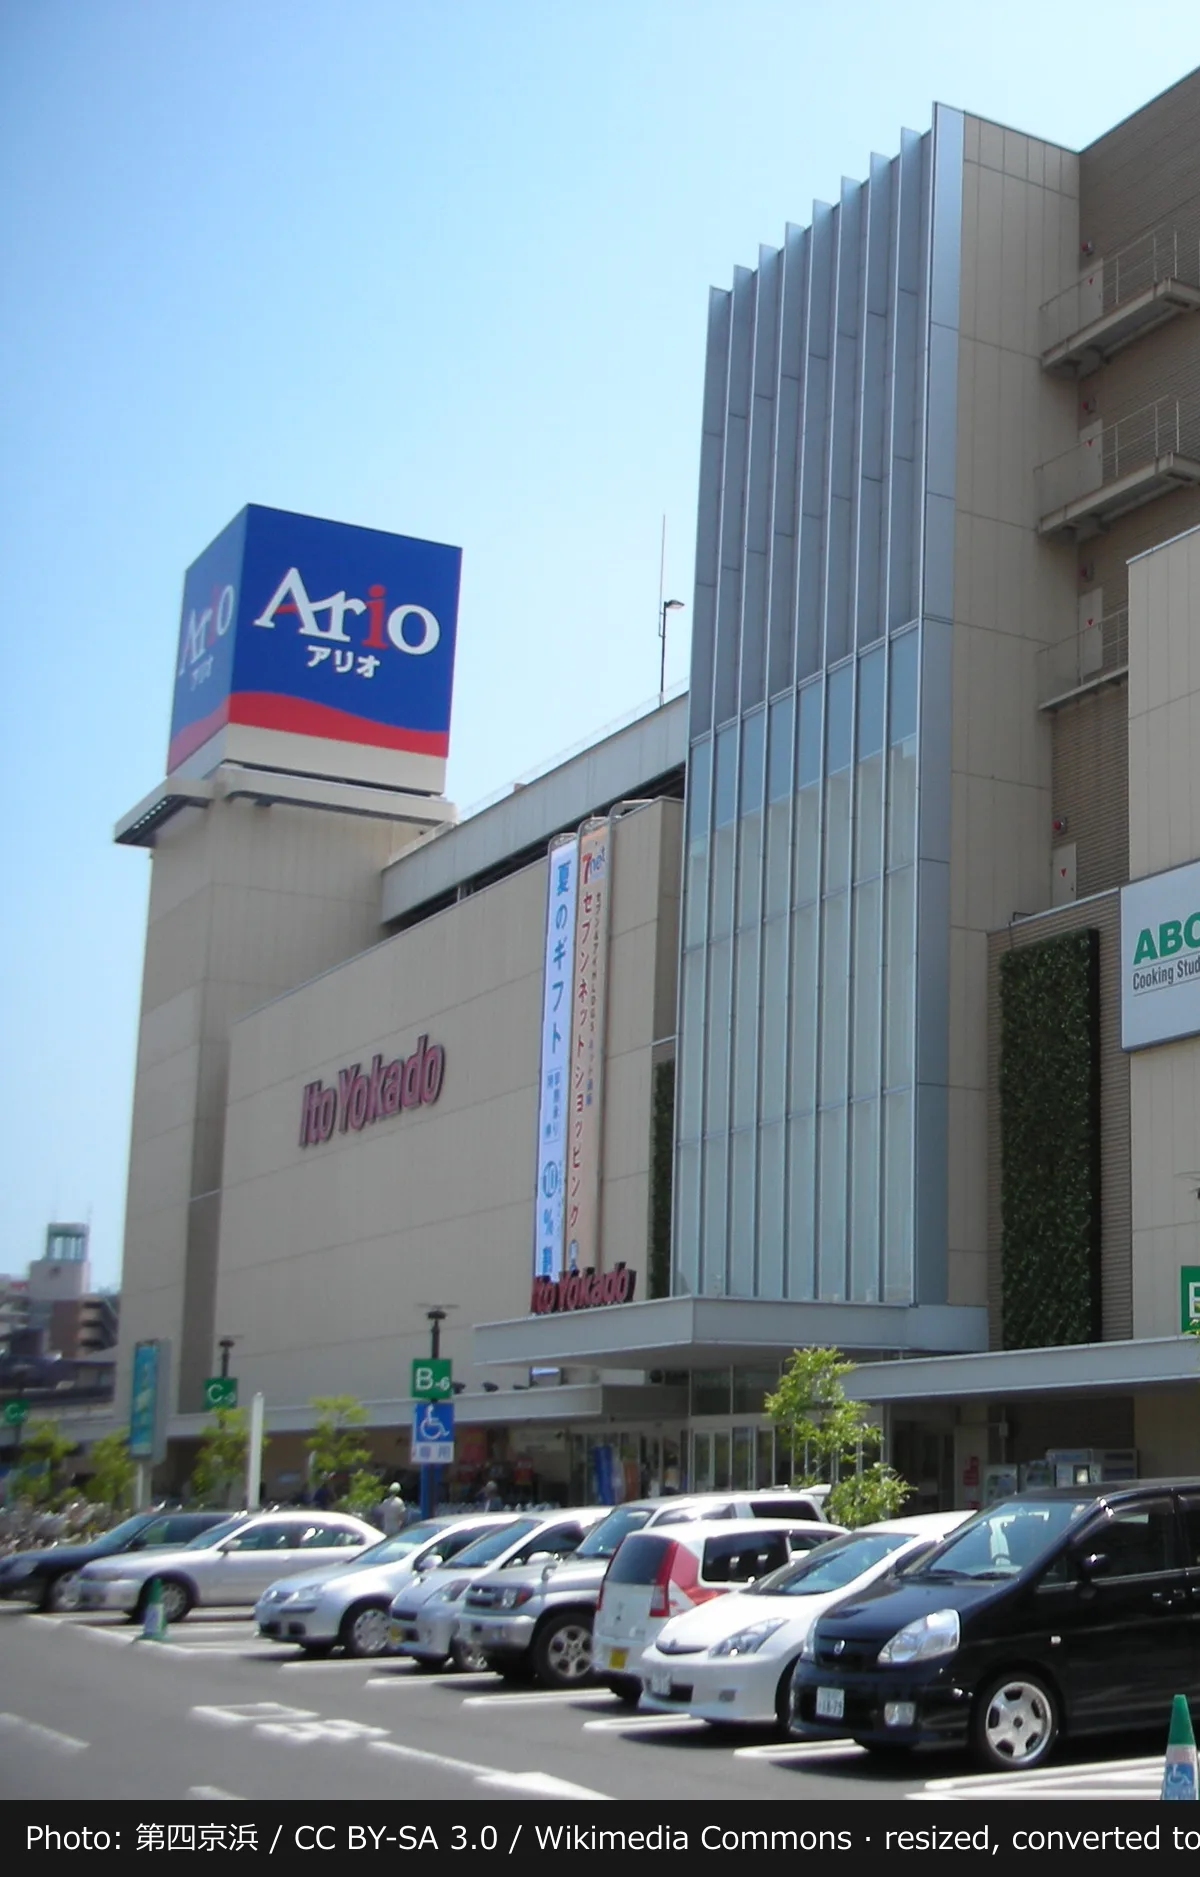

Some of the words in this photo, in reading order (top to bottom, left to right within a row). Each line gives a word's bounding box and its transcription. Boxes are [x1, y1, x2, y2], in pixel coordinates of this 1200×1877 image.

[254, 567, 440, 655] Ario
[307, 644, 381, 679] アリオ
[1132, 963, 1174, 991] Cooking
[299, 1079, 338, 1149] Ito
[338, 1033, 446, 1135] Yokado
[557, 1262, 637, 1313] Yokado
[415, 1367, 451, 1392] B-6
